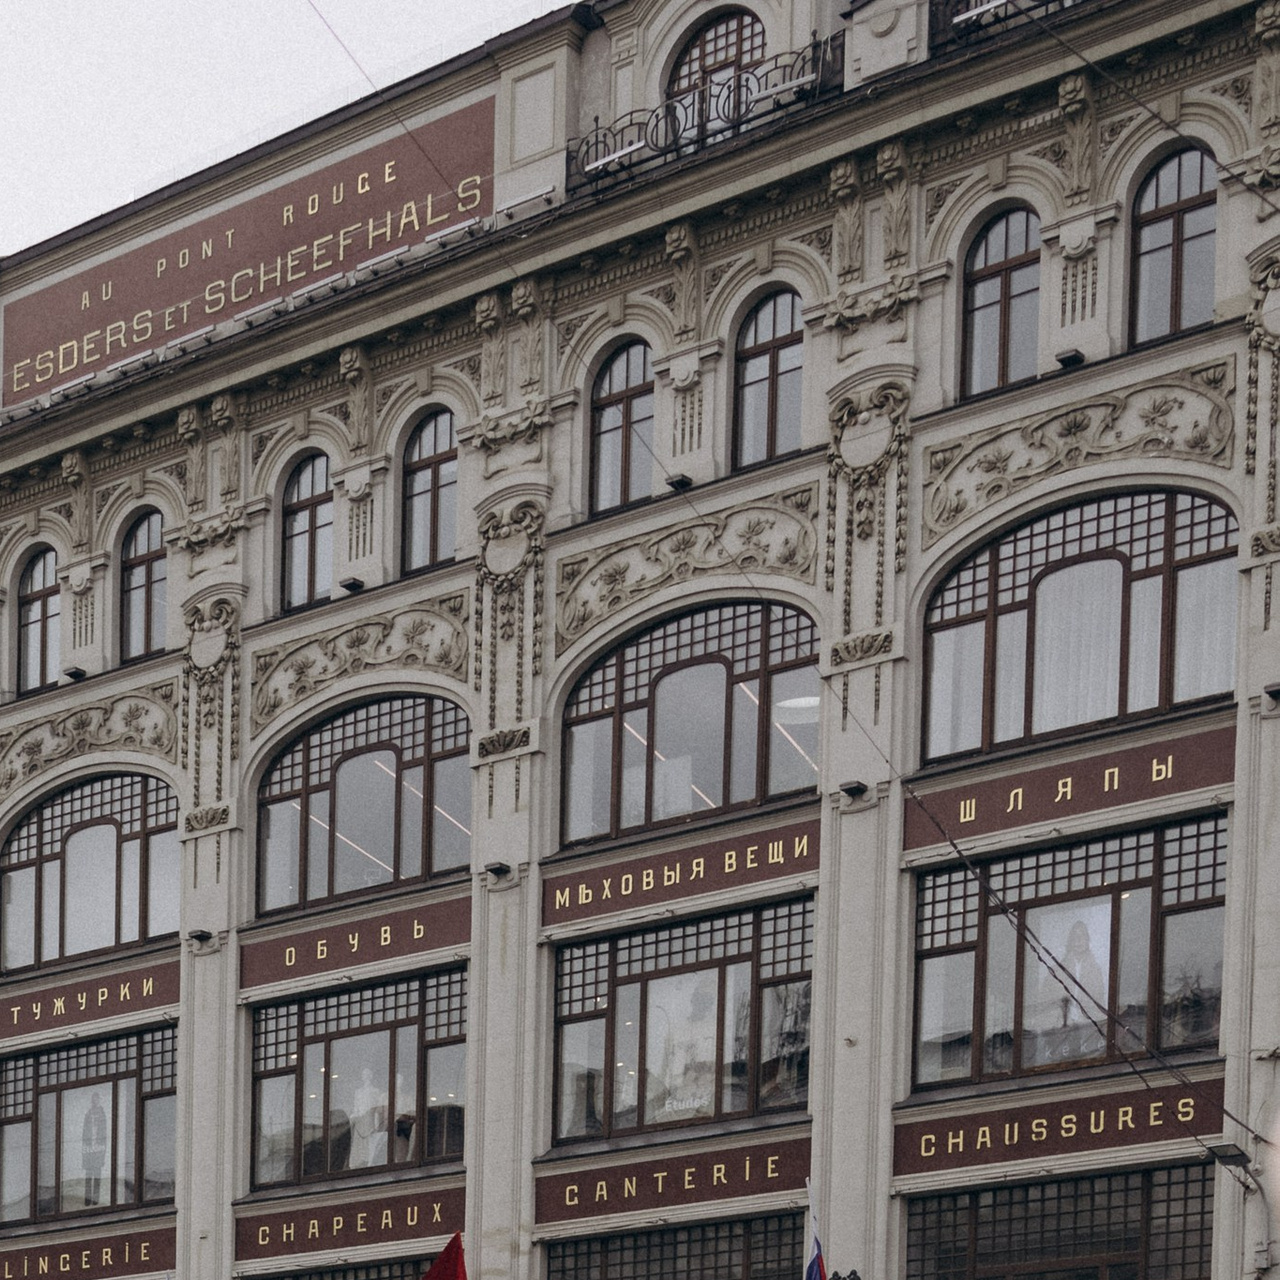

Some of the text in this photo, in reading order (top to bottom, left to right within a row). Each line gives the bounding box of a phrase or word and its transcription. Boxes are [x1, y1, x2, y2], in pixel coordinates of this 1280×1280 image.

[80, 160, 398, 311] AU PONT ROUGE
[12, 174, 482, 392] ESDERS ET SCHEEFHALS
[959, 754, 1175, 825] ШЛЯПЫ
[723, 832, 811, 874] ВЕЩИ
[284, 918, 427, 968] ОБУВЬ
[9, 976, 156, 1026] ТУЖУРКИ
[920, 1097, 1195, 1158] CHAUSSURES
[258, 1201, 443, 1247] CHAPEAUX
